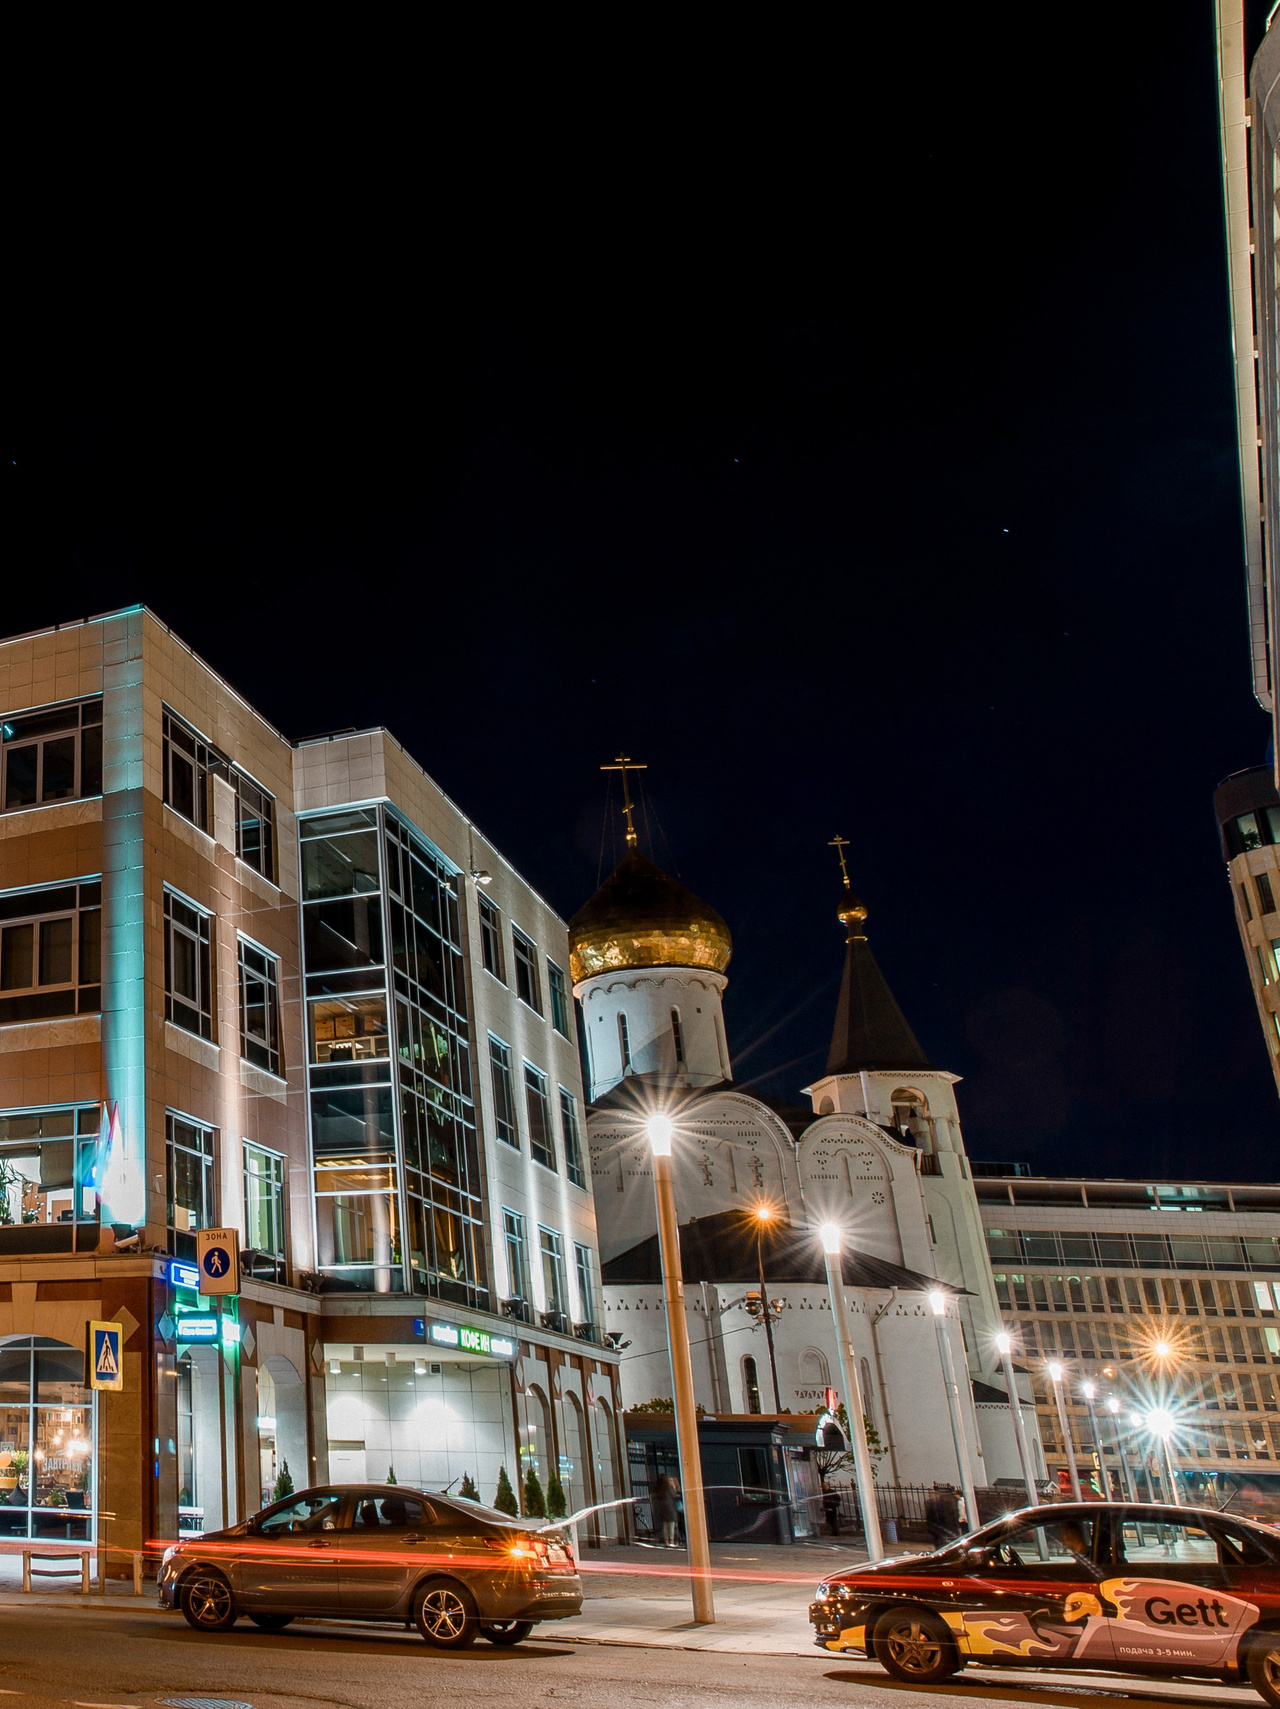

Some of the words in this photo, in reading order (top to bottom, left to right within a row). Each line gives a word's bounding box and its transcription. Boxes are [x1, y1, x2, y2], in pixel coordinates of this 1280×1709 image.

[205, 1232, 228, 1241] ЗОНА
[460, 1328, 480, 1351] КОФЕ
[480, 1333, 491, 1353] ИН
[1144, 1596, 1229, 1627] Gett
[1119, 1646, 1154, 1655] подача
[1156, 1648, 1172, 1656] 3-5
[1172, 1649, 1196, 1658] мин.
